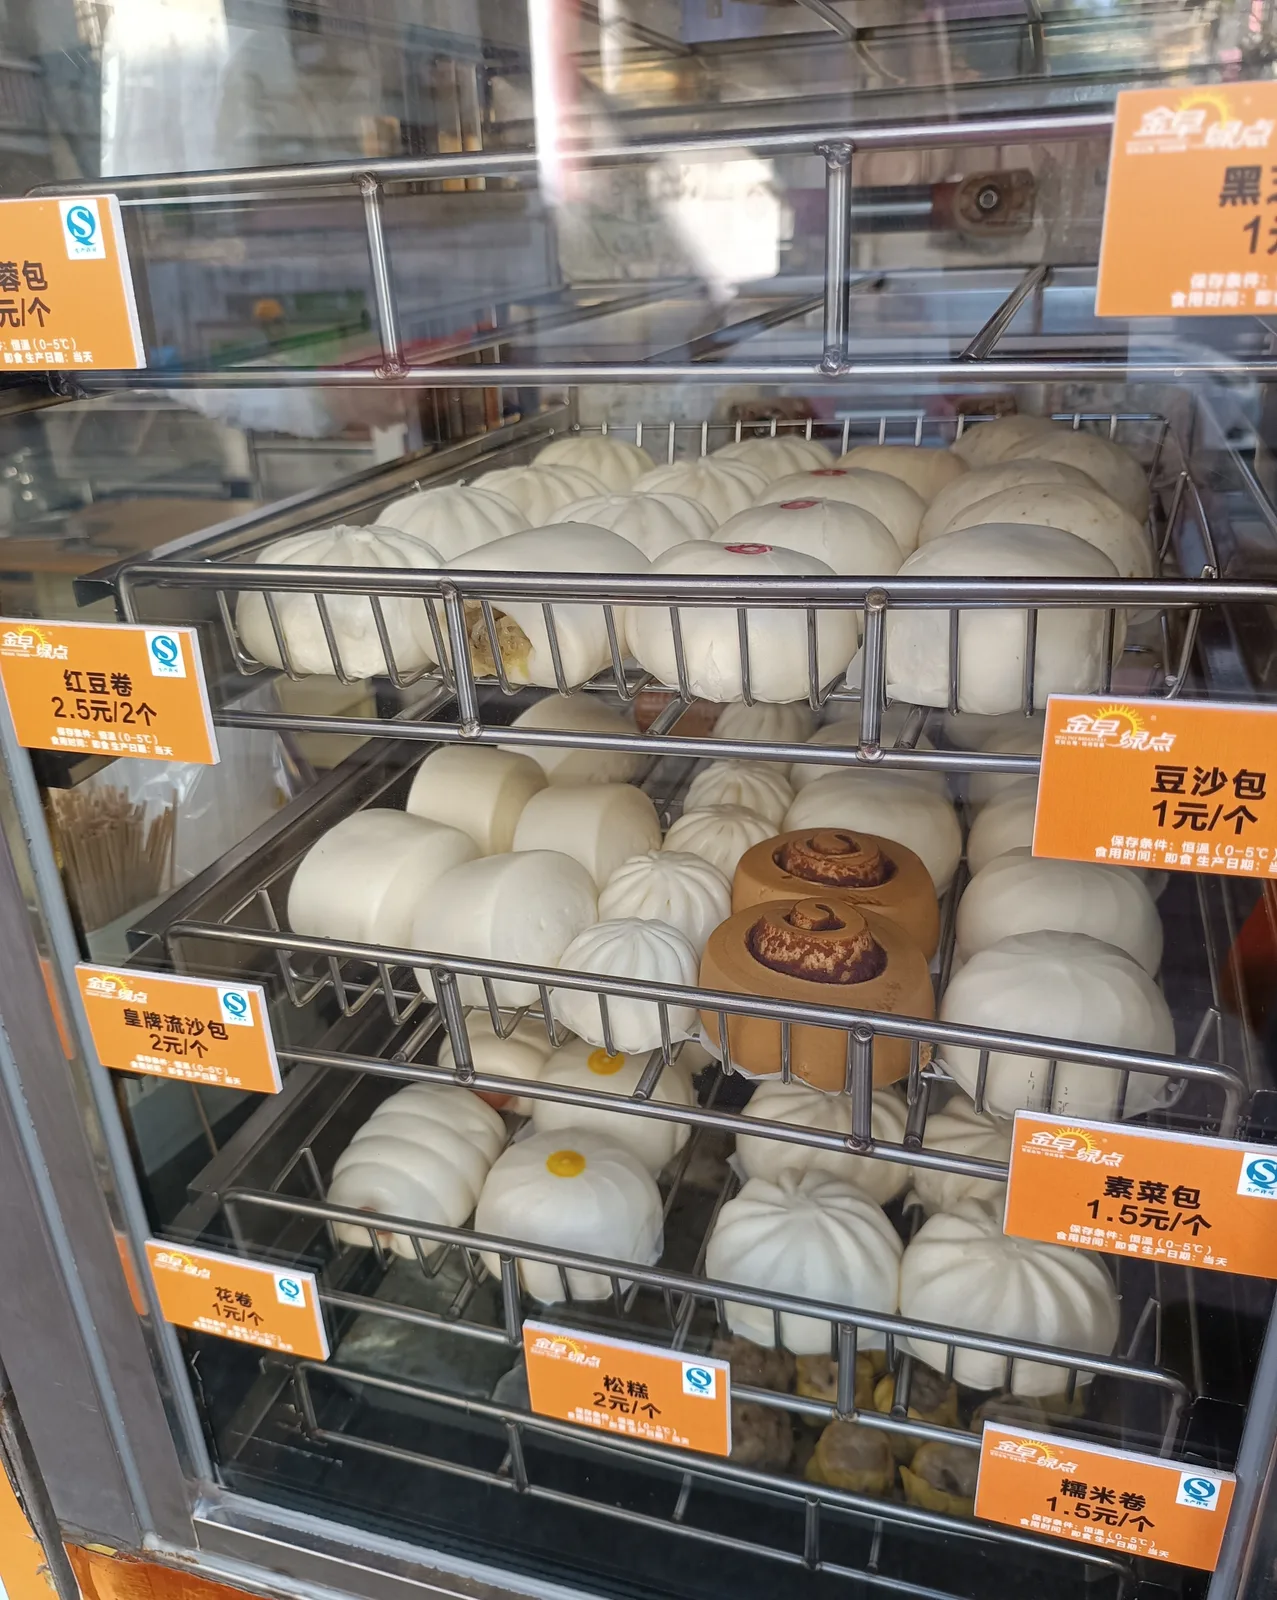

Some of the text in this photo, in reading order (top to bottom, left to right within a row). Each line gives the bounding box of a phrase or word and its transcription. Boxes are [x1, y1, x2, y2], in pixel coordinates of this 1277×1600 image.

[0, 260, 48, 292] 蓉包
[63, 669, 133, 697] 红豆卷
[51, 696, 158, 726] 2.5元/2个
[1150, 764, 1267, 800] 豆沙包
[1152, 800, 1259, 835] 1元/个
[123, 1008, 229, 1041] 皇牌流沙包
[150, 1034, 209, 1059] 2元/个
[1103, 1175, 1202, 1210] 素菜包
[1087, 1199, 1212, 1237] 1.5元/个
[215, 1286, 253, 1308] 花卷
[212, 1303, 264, 1326] 1元/个
[603, 1375, 649, 1400] 松糕
[593, 1392, 662, 1419] 2元/个
[1060, 1478, 1146, 1511] 糯米卷
[1046, 1496, 1156, 1533] 1.5元/个
